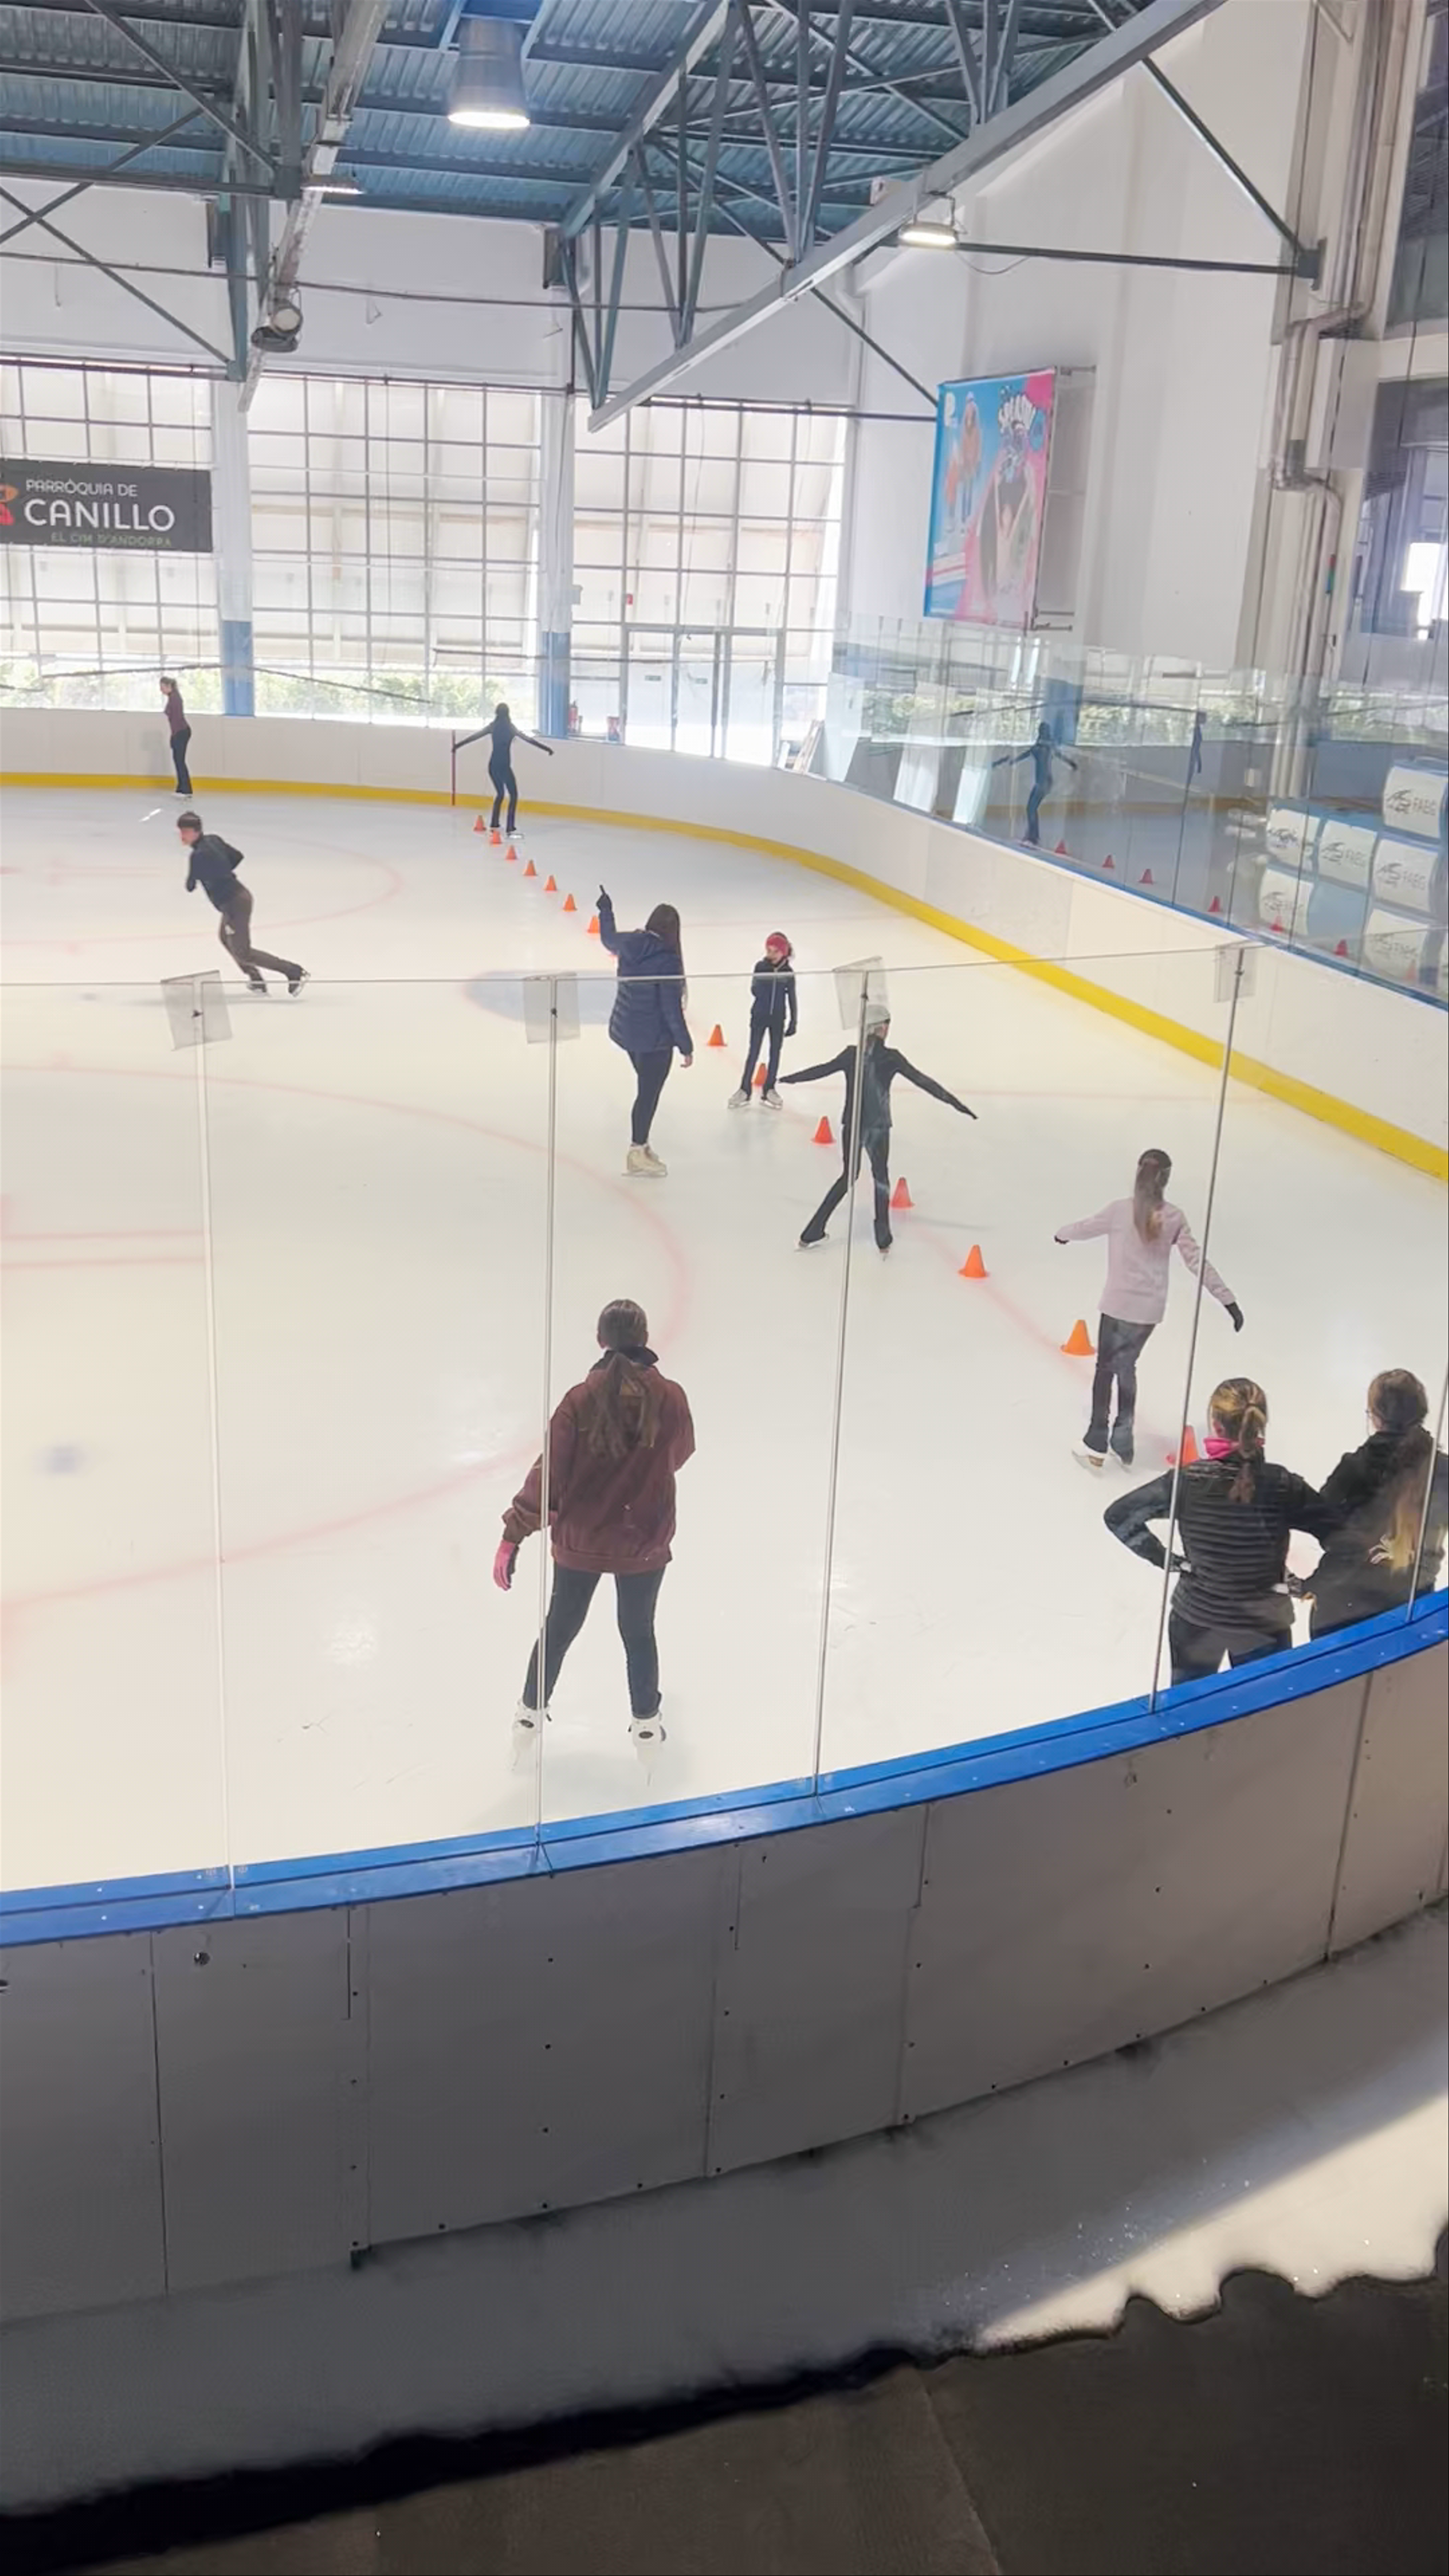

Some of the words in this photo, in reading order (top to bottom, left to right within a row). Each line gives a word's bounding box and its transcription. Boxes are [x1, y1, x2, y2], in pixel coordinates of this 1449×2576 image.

[118, 484, 138, 497] DE
[24, 498, 175, 531] CANILLO
[51, 532, 66, 543] EL
